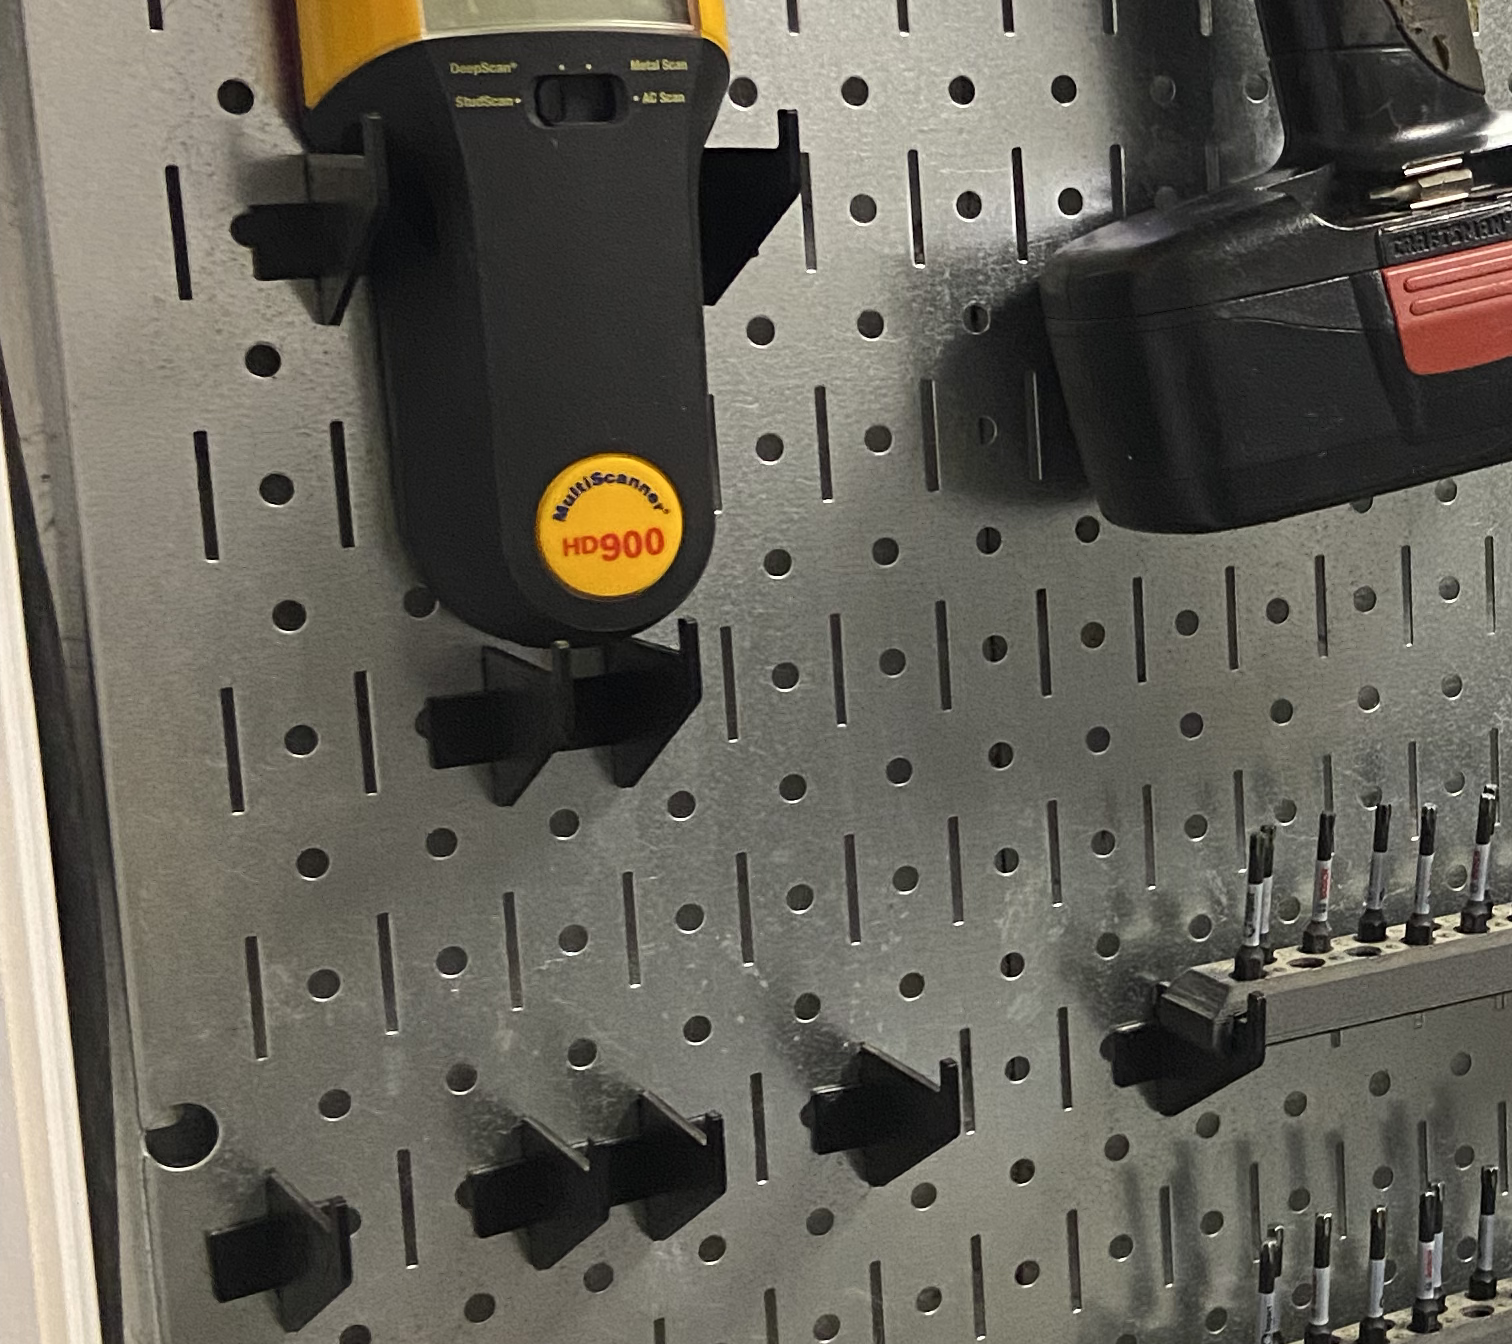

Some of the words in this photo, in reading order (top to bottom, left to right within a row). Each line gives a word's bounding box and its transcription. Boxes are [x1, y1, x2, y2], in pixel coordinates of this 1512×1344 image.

[661, 59, 688, 72] Scan
[455, 95, 515, 108] StudScan
[642, 91, 658, 105] AC
[659, 91, 686, 104] Scan
[552, 471, 664, 523] MultiScanner
[562, 527, 665, 562] HD900
